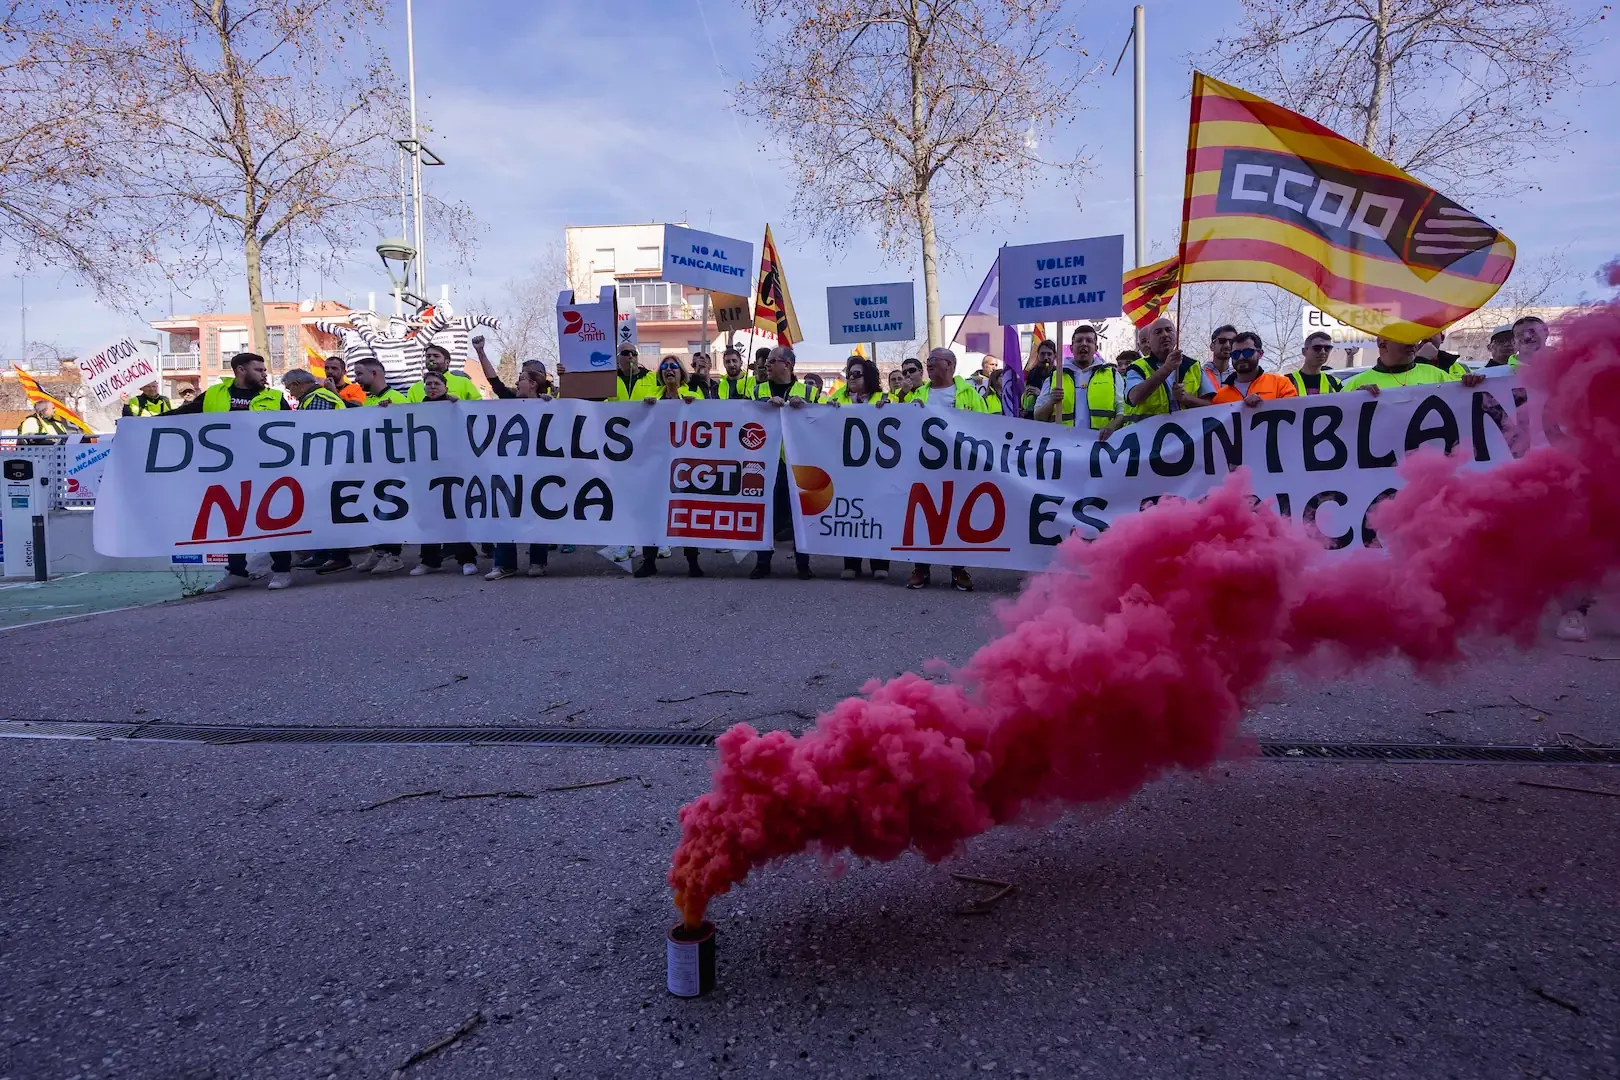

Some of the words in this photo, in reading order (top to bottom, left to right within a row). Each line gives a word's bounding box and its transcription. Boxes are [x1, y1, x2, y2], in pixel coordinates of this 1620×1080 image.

[1231, 163, 1404, 240] CCOO
[692, 244, 709, 256] NO
[712, 248, 727, 260] AL
[1036, 255, 1085, 271] VOLEM
[671, 254, 745, 278] TANCAMENT
[1034, 274, 1087, 290] SEGUIR
[854, 296, 888, 306] VOLEM
[1017, 290, 1106, 309] TREBALLANT
[719, 307, 742, 322] RIP
[853, 310, 890, 320] SEGUIR
[1308, 310, 1331, 327] EL
[578, 330, 606, 342] Smith
[583, 322, 597, 333] DS
[842, 322, 903, 333] TREBALLANT
[91, 351, 110, 375] HAY
[92, 380, 113, 402] HAY
[145, 423, 234, 473] DS
[258, 413, 438, 468] Smith
[466, 413, 634, 462] VALLS
[669, 420, 733, 449] UGT
[75, 448, 87, 462] NO
[88, 447, 98, 455] AL
[842, 416, 901, 469] DS
[918, 416, 1063, 480] Smith
[68, 448, 111, 476] TANCAMENT
[673, 462, 737, 491] CGT
[743, 487, 763, 496] CGT
[191, 476, 305, 540] NO
[330, 479, 409, 524] ES
[429, 474, 614, 521] TANCA
[835, 497, 864, 519] DS
[902, 481, 1006, 546] NO
[1028, 493, 1110, 545] ES
[670, 507, 758, 532] CCOO
[820, 515, 882, 540] Smith
[24, 540, 32, 567] etecnic
